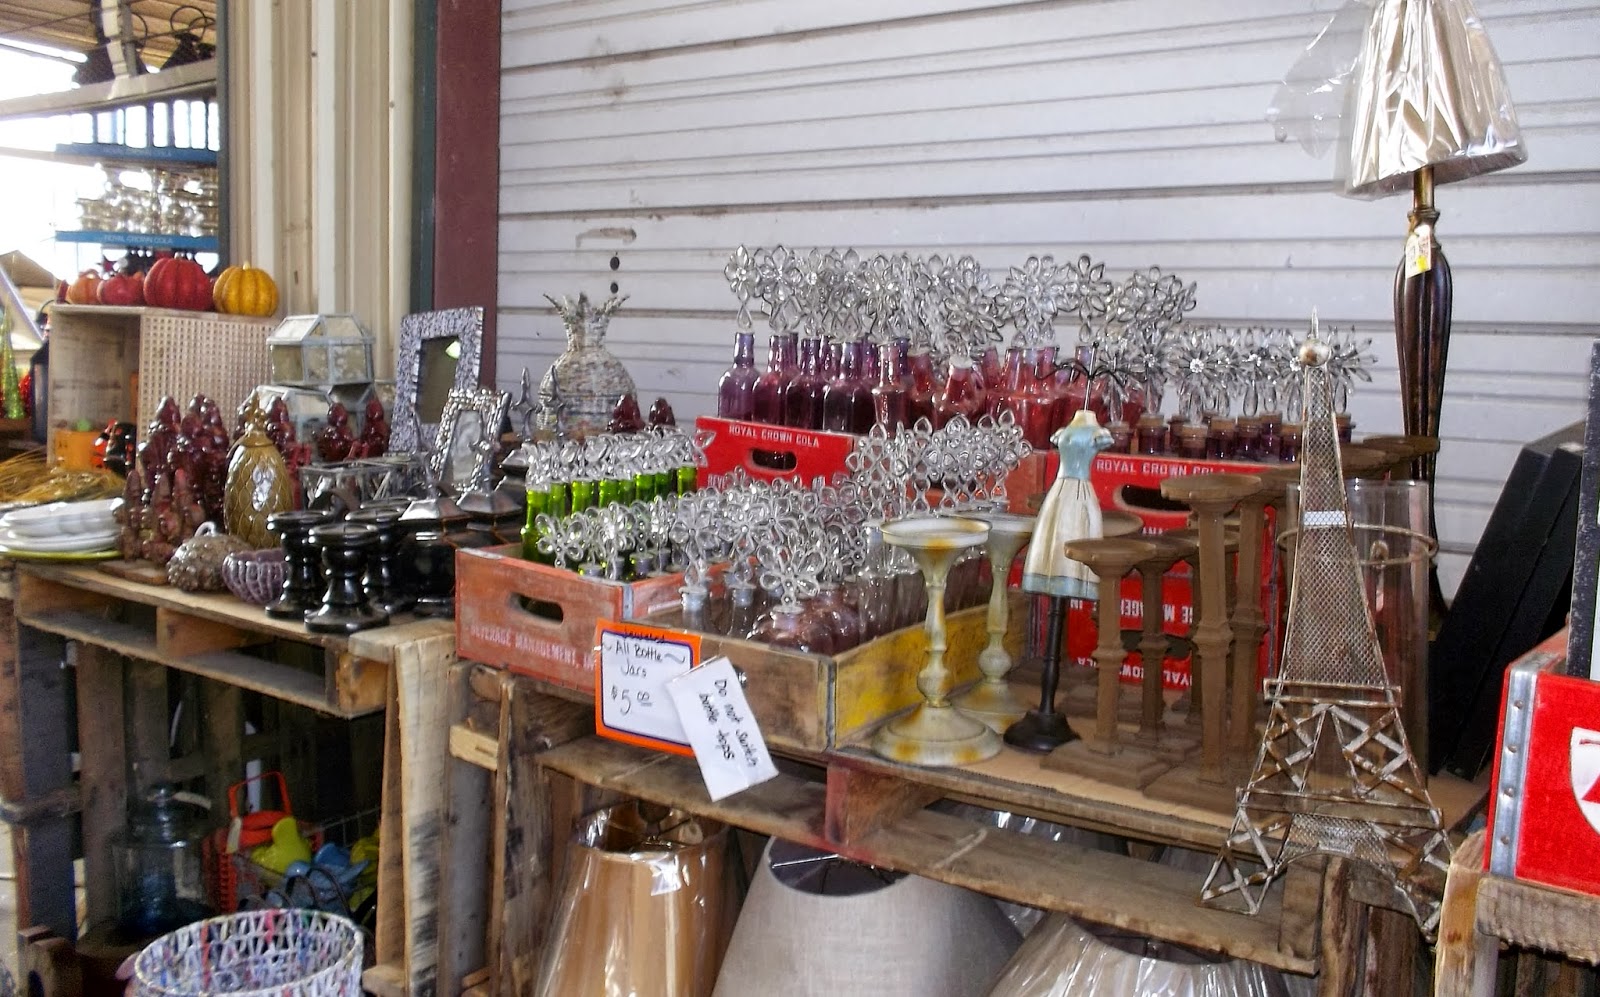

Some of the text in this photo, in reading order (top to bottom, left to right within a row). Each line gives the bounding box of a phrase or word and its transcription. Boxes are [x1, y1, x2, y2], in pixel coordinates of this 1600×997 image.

[729, 424, 820, 448] ROYAL CROWN COLA
[1096, 459, 1136, 473] ROYAL
[1142, 463, 1187, 476] CROWN
[615, 640, 663, 662] All Bottle
[620, 658, 647, 678] Jars
[714, 679, 727, 697] Do
[724, 703, 743, 723] not
[715, 730, 735, 761] tops
